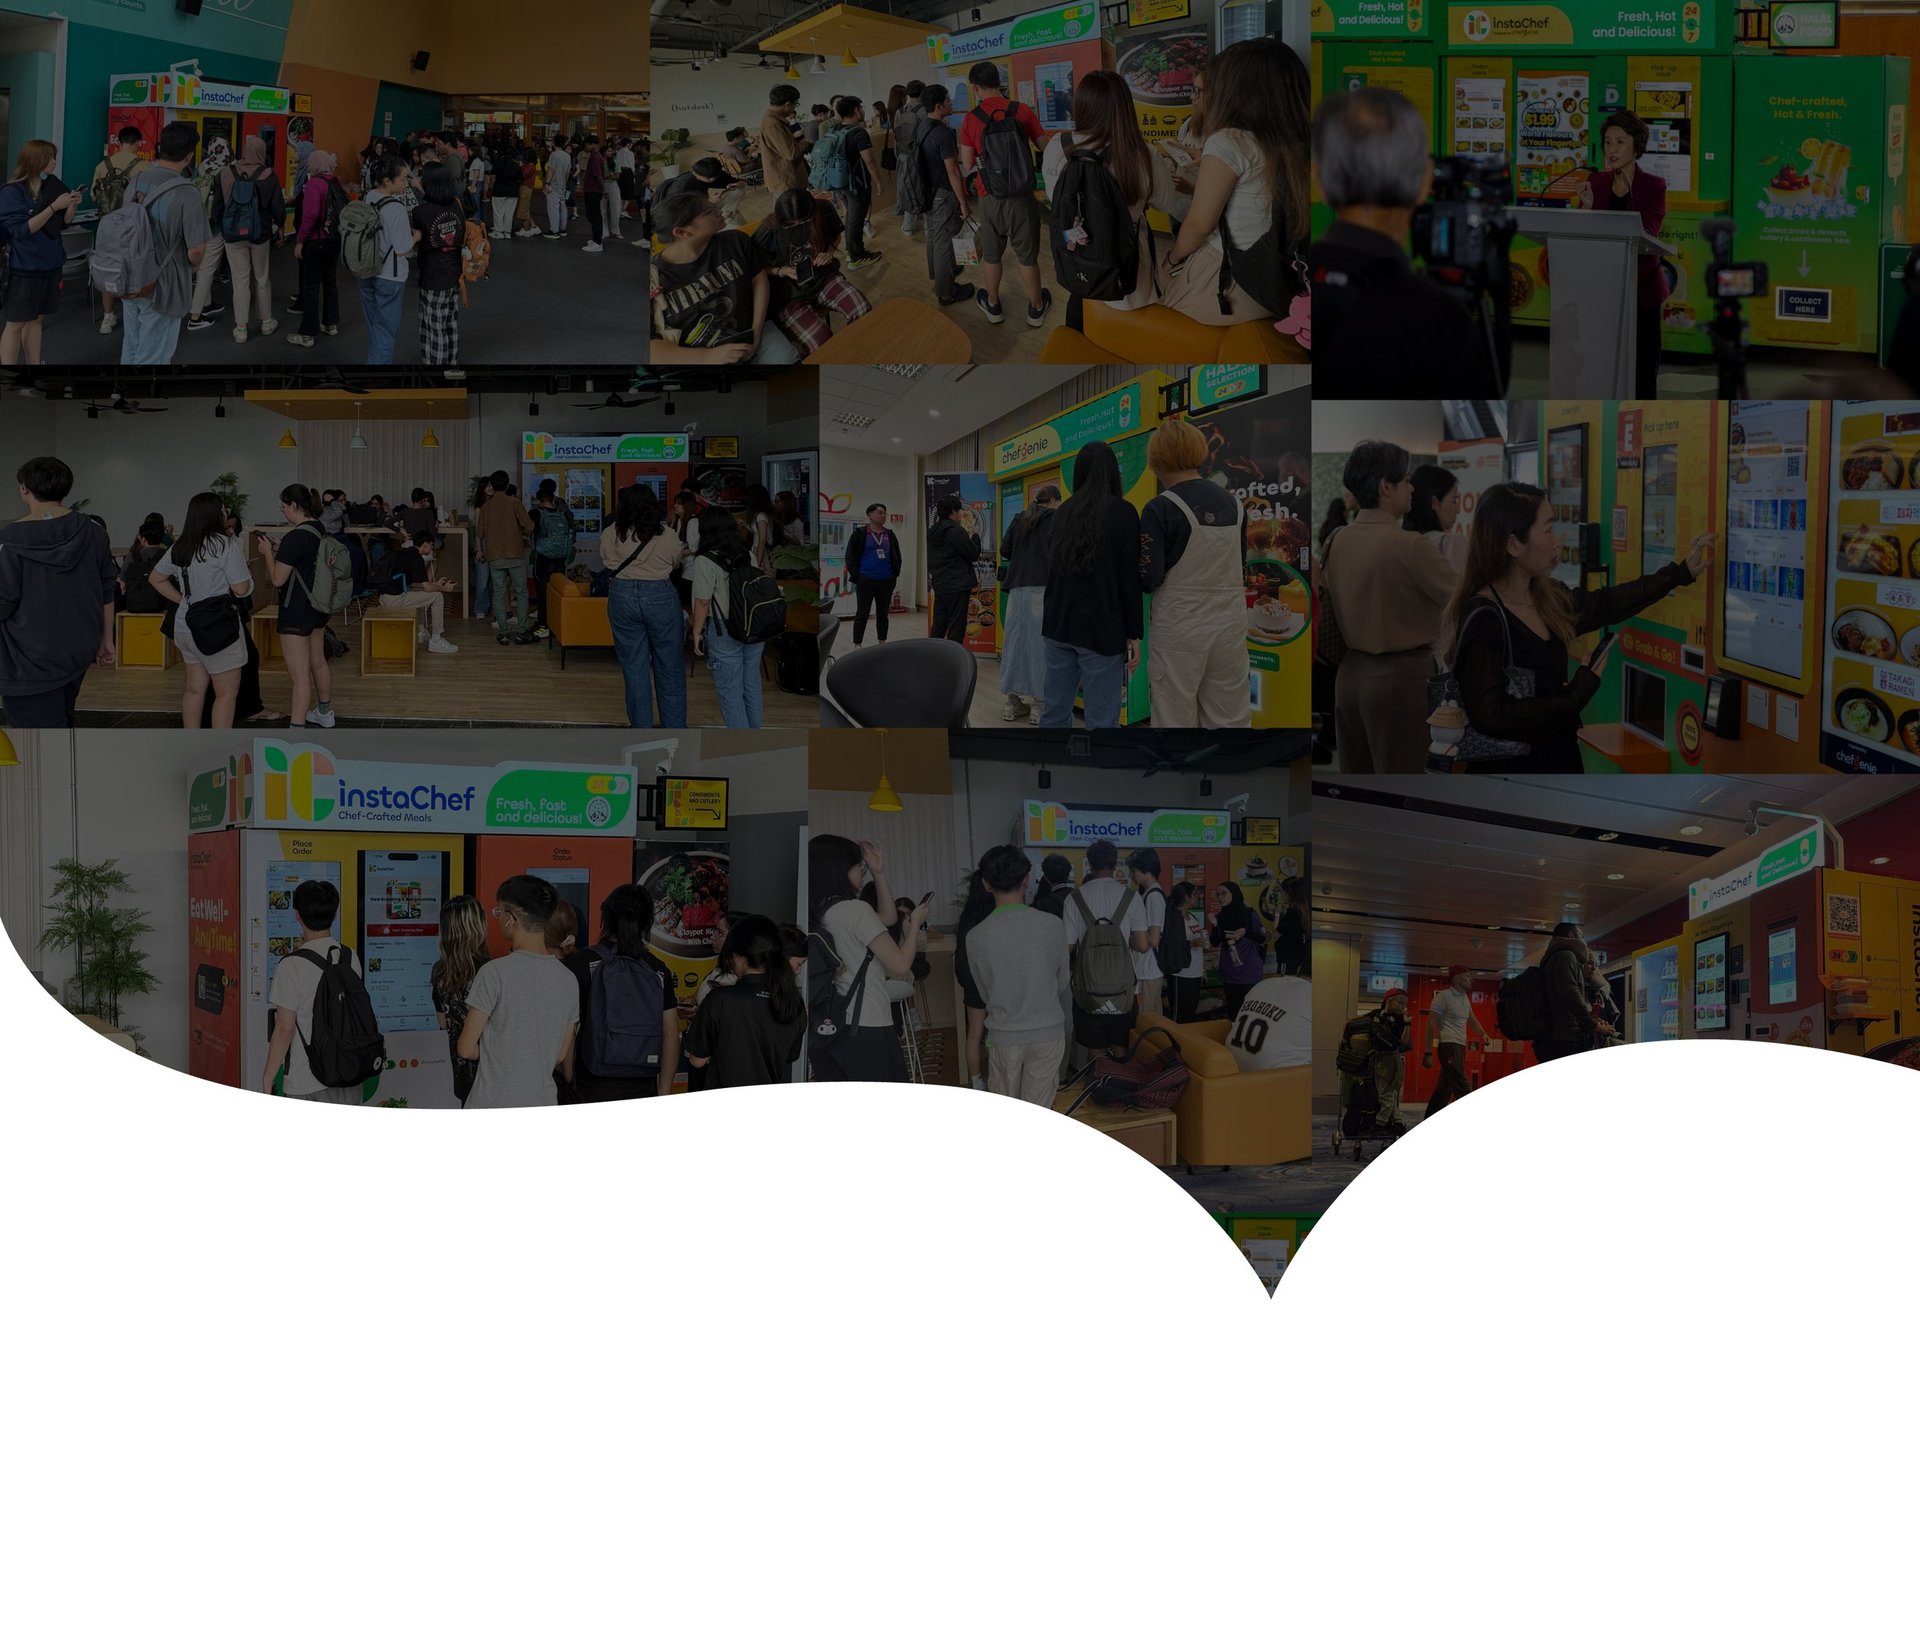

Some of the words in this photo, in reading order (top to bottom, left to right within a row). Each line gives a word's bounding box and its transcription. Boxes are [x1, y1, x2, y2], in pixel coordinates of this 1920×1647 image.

[1359, 2, 1385, 12] Fresh,
[1388, 2, 1404, 11] Hot
[1685, 6, 1697, 15] 24
[1339, 15, 1356, 24] and
[1359, 15, 1403, 24] Delicious!
[1618, 11, 1653, 22] Fresh,
[1656, 11, 1677, 22] Hot
[1802, 14, 1832, 24] HALAL
[1493, 17, 1549, 28] instaChef
[1593, 27, 1616, 37] and
[1619, 26, 1675, 37] Delicious!
[1688, 33, 1694, 41] 7
[1802, 27, 1832, 37] FOOD
[952, 33, 1004, 54] instaChef
[201, 90, 245, 104] instaChef
[1605, 88, 1619, 103] D
[1769, 97, 1847, 107] Chef-crafted,
[1774, 109, 1793, 119] Hot
[1796, 109, 1805, 119] &
[1807, 110, 1842, 119] Fresh.
[1672, 231, 1698, 241] right!
[665, 259, 744, 317] NIRVANA
[1789, 296, 1822, 306] COLLECT
[1795, 305, 1816, 315] HERE
[1206, 367, 1255, 388] SELECTION
[1624, 423, 1633, 451] E
[554, 444, 612, 455] instaChef
[1246, 502, 1297, 521] esh.
[1635, 640, 1653, 654] Grab
[1661, 648, 1676, 664] Go!
[1888, 672, 1915, 686] TAKAGI
[1888, 683, 1915, 697] RAMEN
[339, 779, 475, 811] instaChef
[495, 797, 536, 812] Fresh,
[339, 811, 401, 821] Chef-Crafted
[404, 814, 432, 823] Meals
[496, 811, 521, 823] and
[523, 811, 582, 825] delicious!
[1069, 820, 1143, 836] instaChef
[292, 840, 312, 848] Place
[1709, 871, 1753, 900] instaChef
[680, 929, 703, 938] Claypot
[1231, 1015, 1268, 1054] 10
